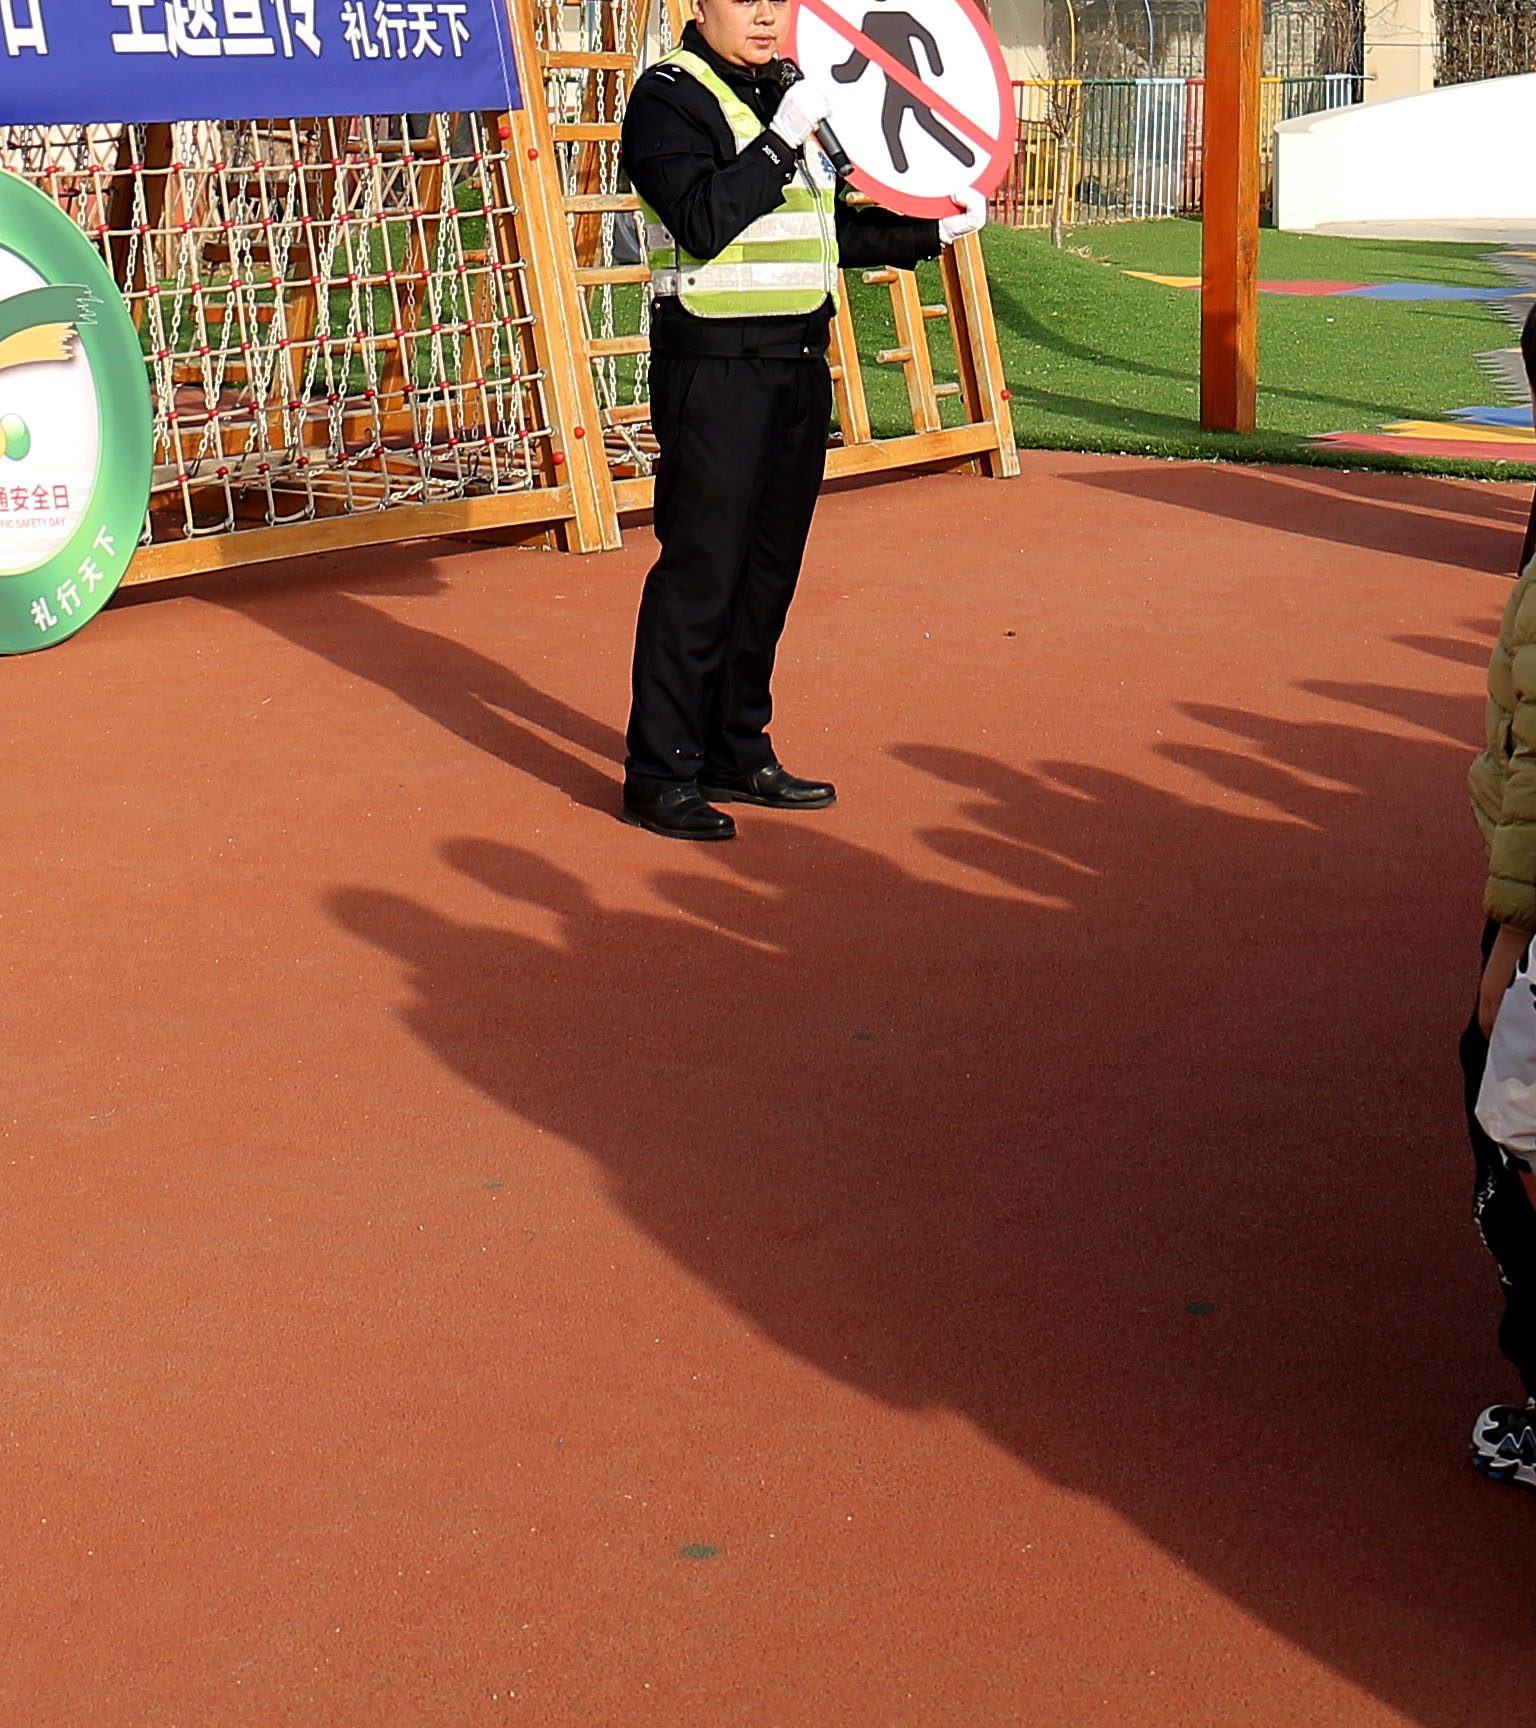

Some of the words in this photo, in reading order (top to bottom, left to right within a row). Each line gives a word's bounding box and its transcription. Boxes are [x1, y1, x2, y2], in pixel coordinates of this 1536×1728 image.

[340, 0, 470, 60] 礼行天下
[15, 518, 46, 528] SAFETY
[48, 517, 66, 526] DAY
[30, 525, 115, 632] 礼行天下
